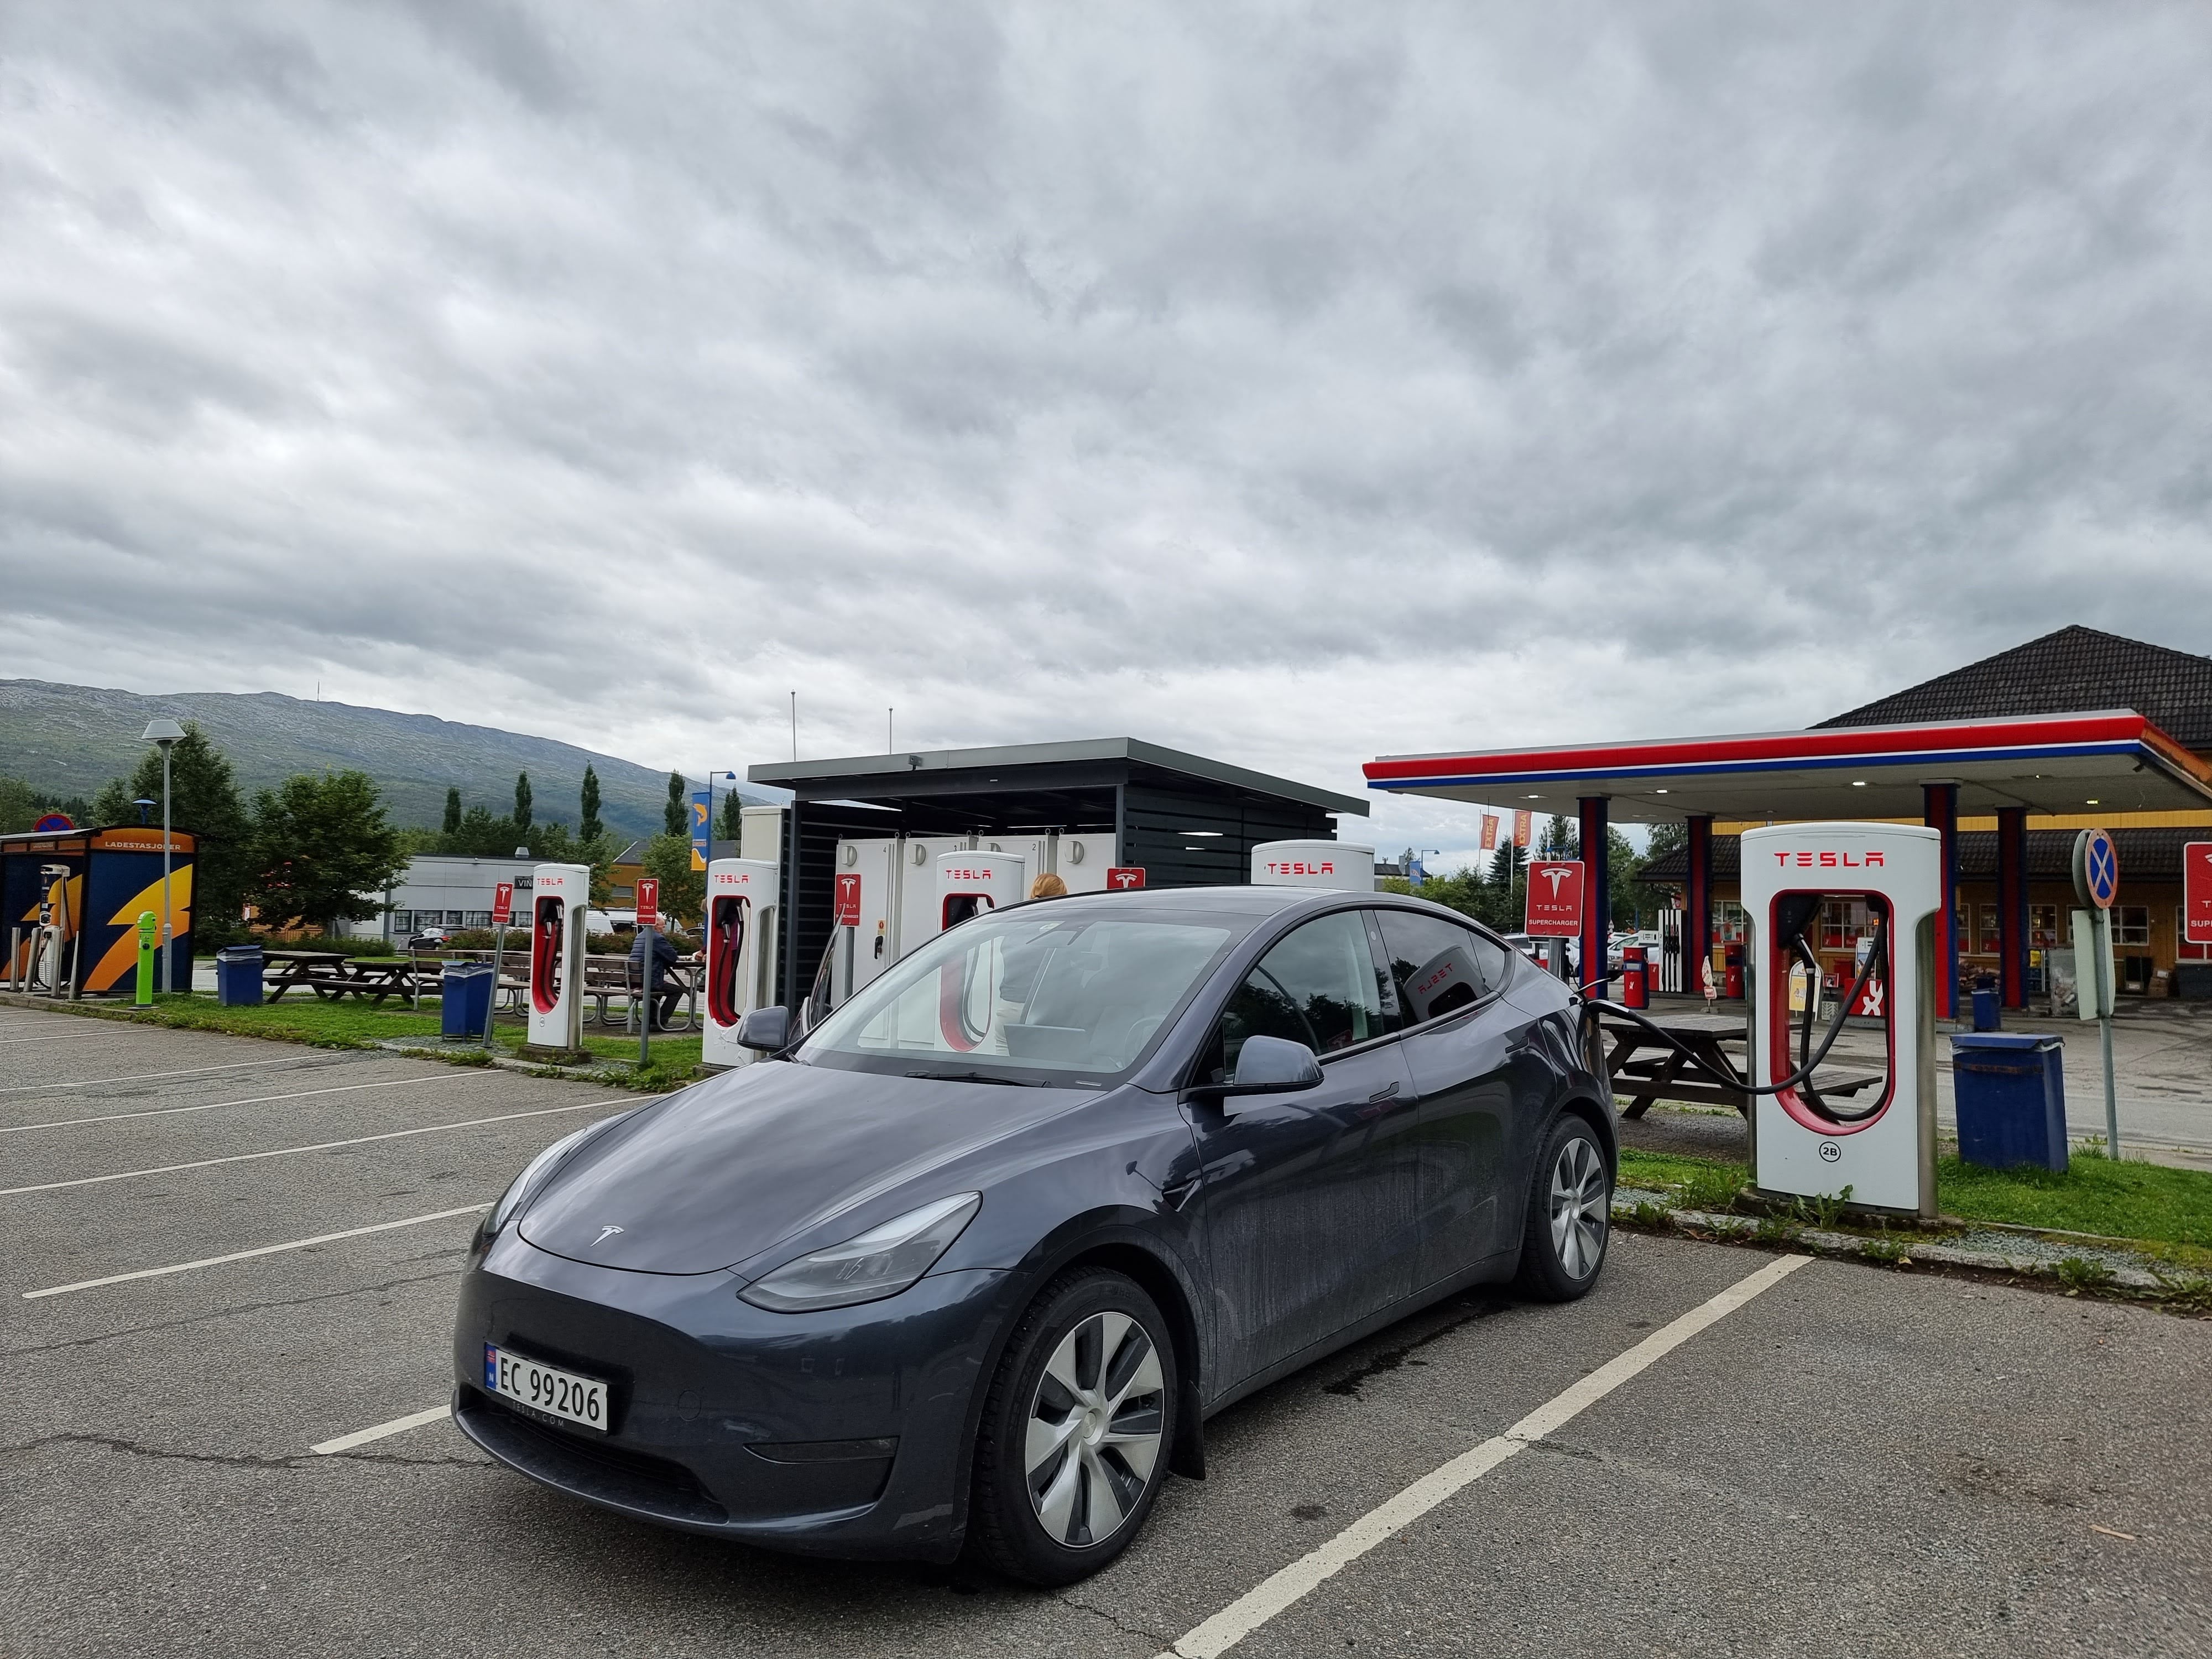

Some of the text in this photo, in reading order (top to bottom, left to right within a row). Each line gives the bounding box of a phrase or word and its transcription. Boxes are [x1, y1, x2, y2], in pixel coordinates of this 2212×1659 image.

[1485, 818, 1494, 848] EXTRA
[105, 841, 181, 851] LADESTASJOER
[1773, 852, 1884, 867] TESLA
[946, 870, 992, 879] TESLA
[1267, 863, 1333, 875] TESLA
[714, 875, 749, 883] TESLA
[1823, 1147, 1838, 1156] 2B
[488, 1372, 494, 1383] N
[500, 1357, 600, 1422] EC 99206
[513, 1401, 565, 1428] TESLA.COM
